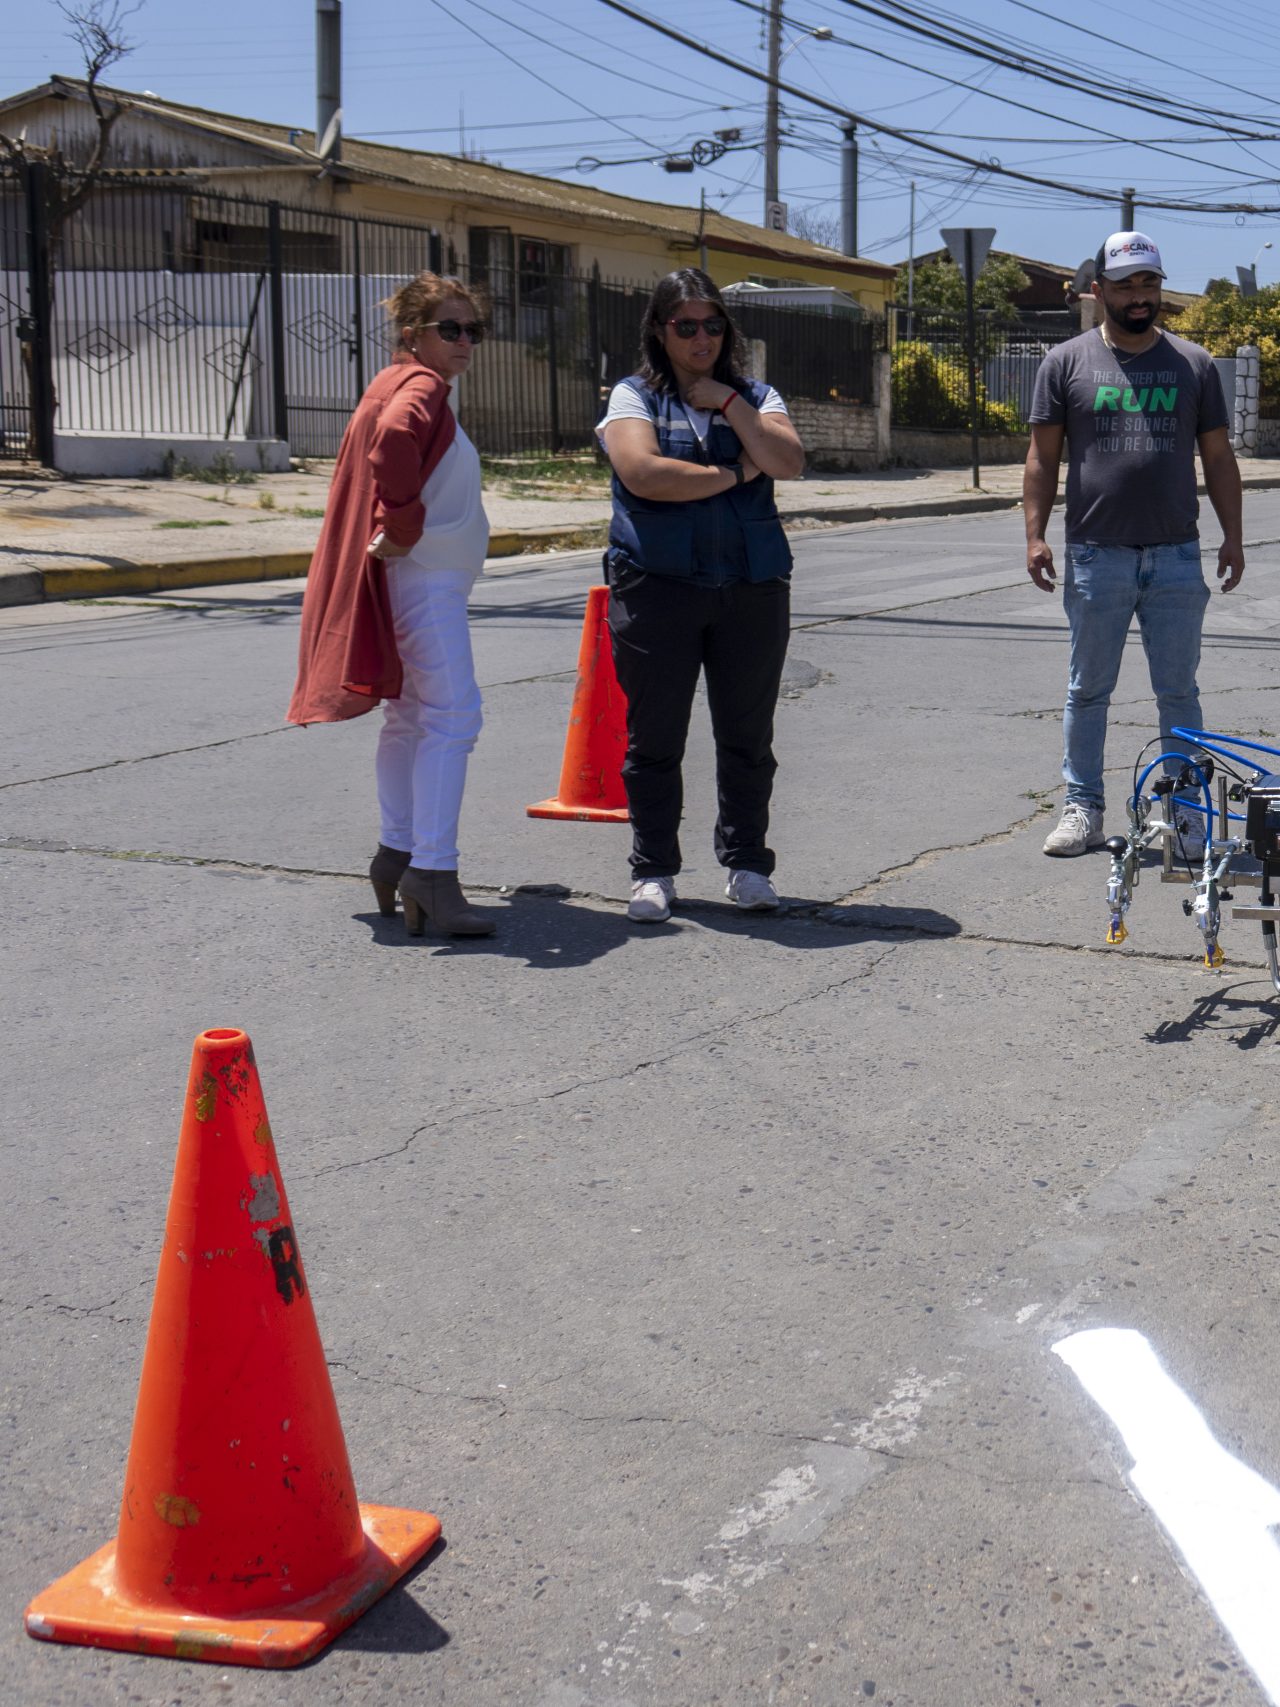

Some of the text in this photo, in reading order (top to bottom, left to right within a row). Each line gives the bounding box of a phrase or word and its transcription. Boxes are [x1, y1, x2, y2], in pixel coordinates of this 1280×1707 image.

[1092, 370, 1177, 384] THE FASTER YOU
[1093, 386, 1178, 412] RUN
[1094, 417, 1177, 432] THE SOONER
[1146, 436, 1176, 452] DONE
